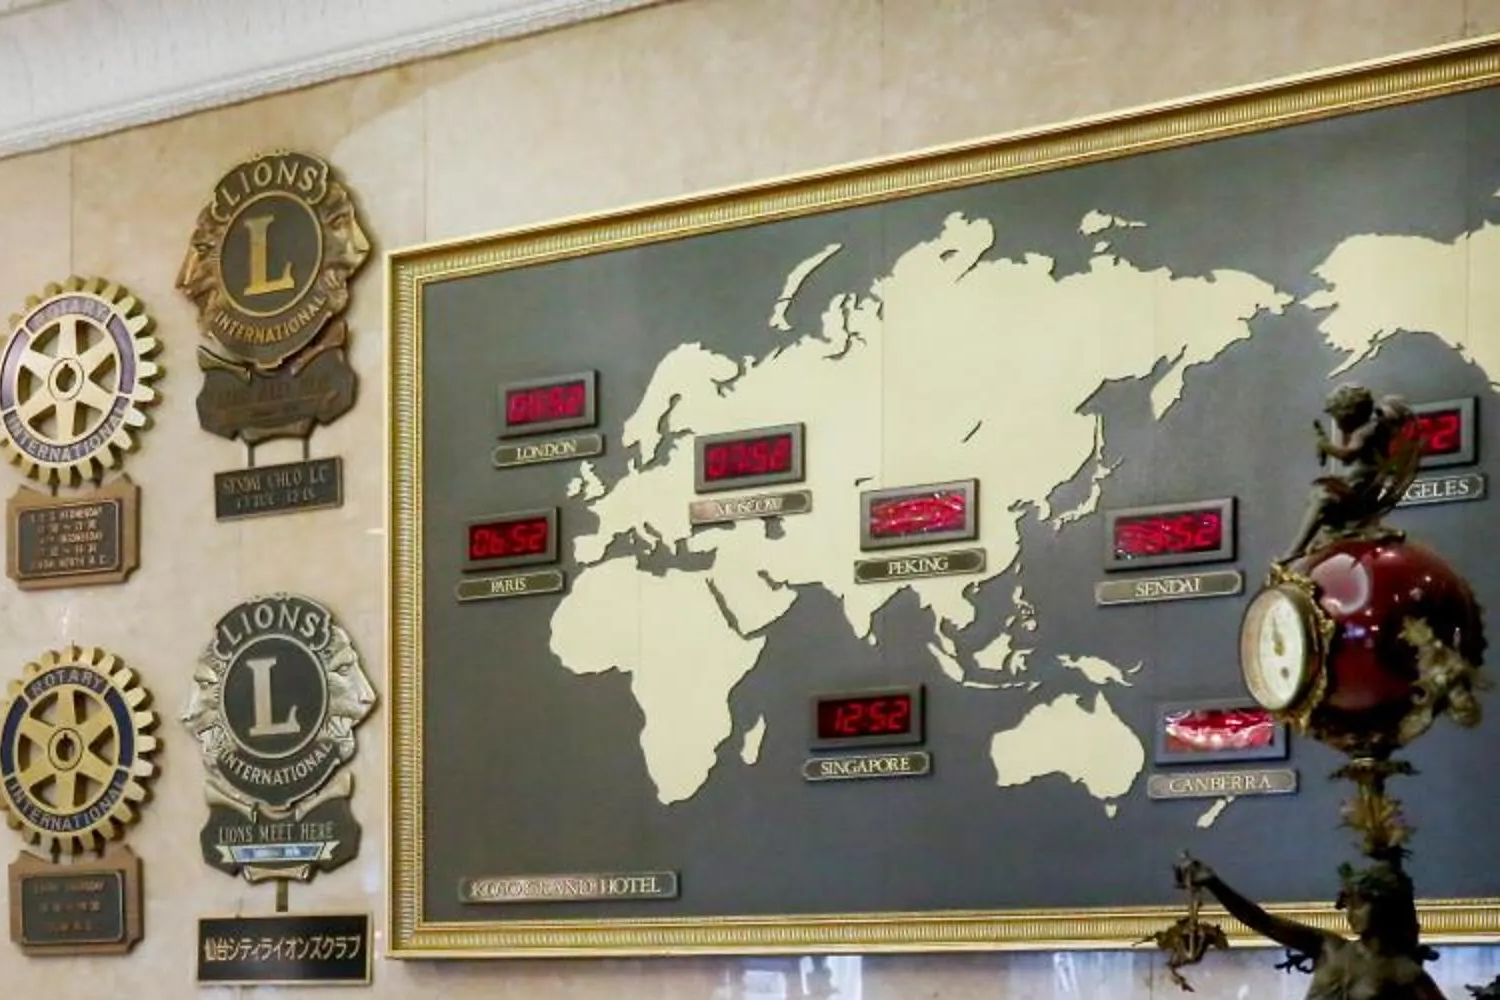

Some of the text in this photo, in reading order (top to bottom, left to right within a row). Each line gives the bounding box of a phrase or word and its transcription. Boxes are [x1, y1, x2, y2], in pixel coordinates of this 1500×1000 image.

[221, 159, 318, 207] LIONS
[243, 211, 295, 297] L
[214, 293, 328, 344] INTERNATIONAL
[5, 406, 125, 462] INTERNATIONAL
[516, 440, 578, 461] LONDON
[1405, 479, 1469, 498] GELES
[888, 556, 949, 575] PEKING
[491, 577, 527, 593] PARIS
[1135, 577, 1201, 597] SENDAI
[222, 604, 321, 646] LIONS
[30, 670, 104, 698] ROTARY
[245, 656, 301, 737] L
[220, 741, 334, 786] INTERNATIONAL
[820, 757, 911, 775] SINGAPORE
[1169, 774, 1273, 793] CANBERRA
[9, 778, 125, 830] INTERNATIONAL
[219, 821, 335, 844] LIONS MEET HERE
[601, 877, 661, 895] HOTEL
